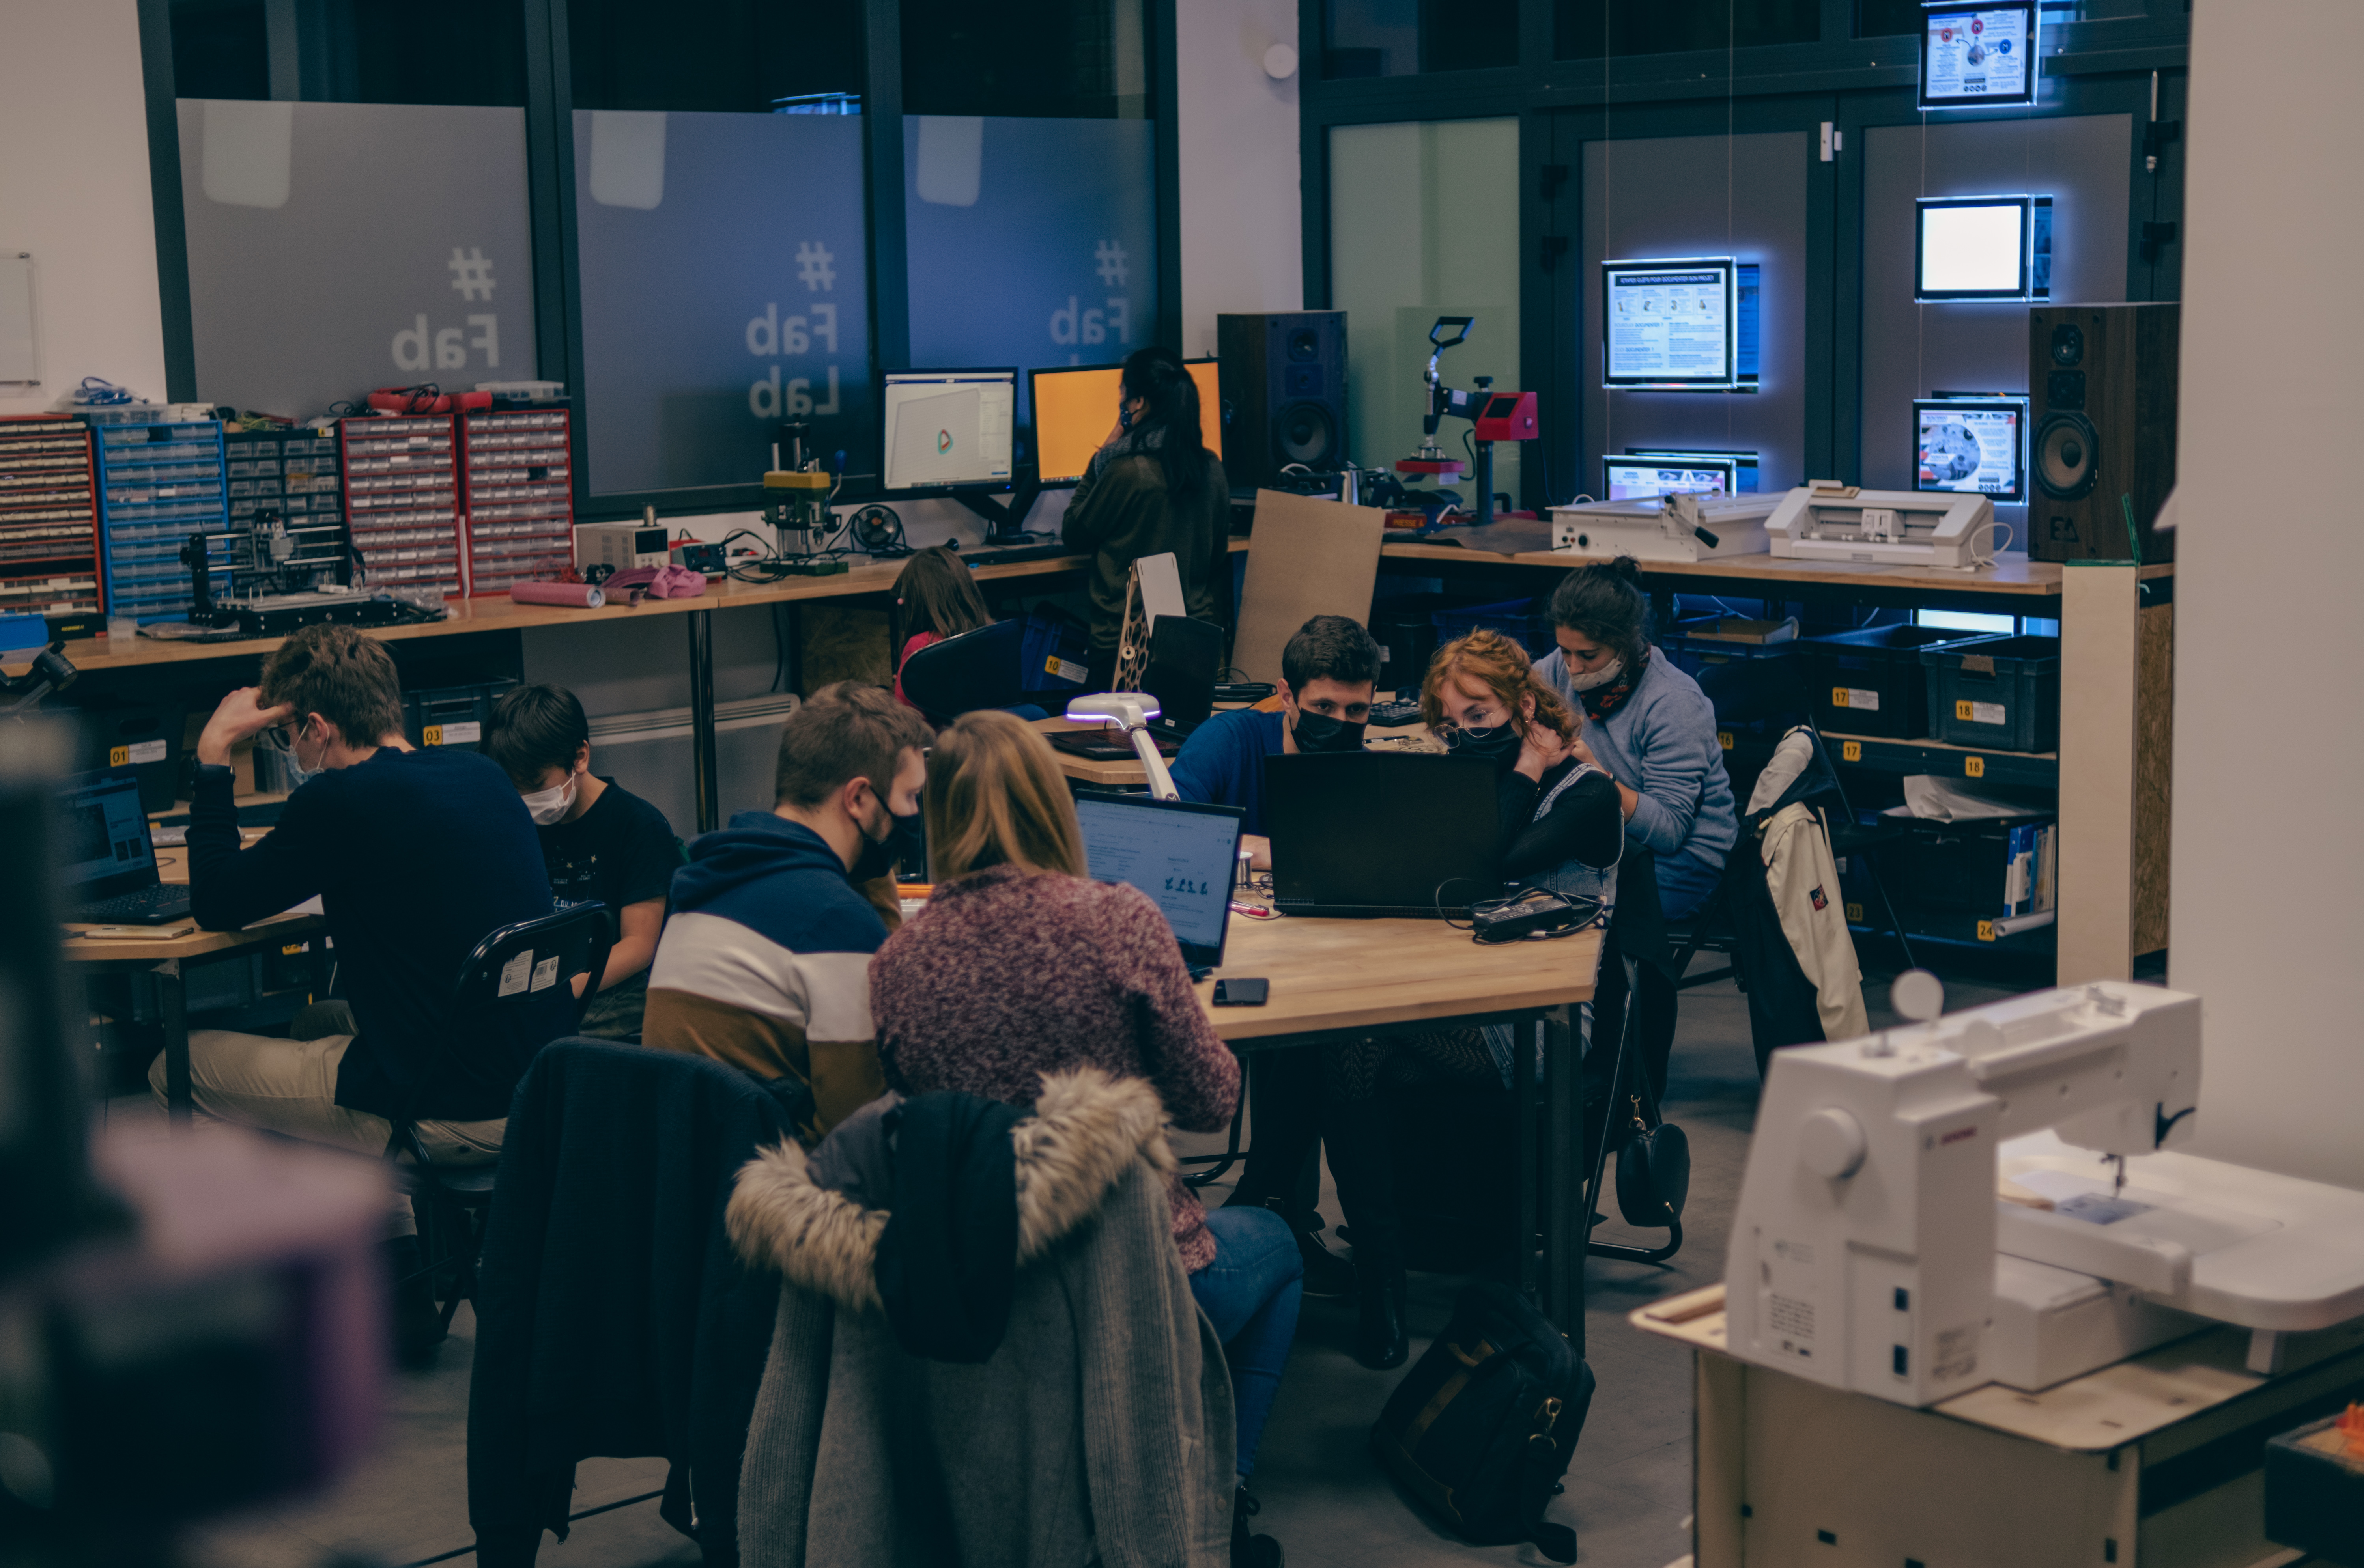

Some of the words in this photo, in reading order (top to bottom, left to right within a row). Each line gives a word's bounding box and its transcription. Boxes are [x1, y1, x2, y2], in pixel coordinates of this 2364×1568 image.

[1049, 660, 1058, 670] 10
[1836, 692, 1845, 702] 17
[1959, 705, 1970, 716] 18
[426, 730, 439, 741] 03
[1721, 735, 1730, 745] 16
[1846, 746, 1857, 756] 17
[113, 751, 125, 763] 01
[1969, 762, 1980, 772] 18
[1981, 926, 1992, 937] 24
